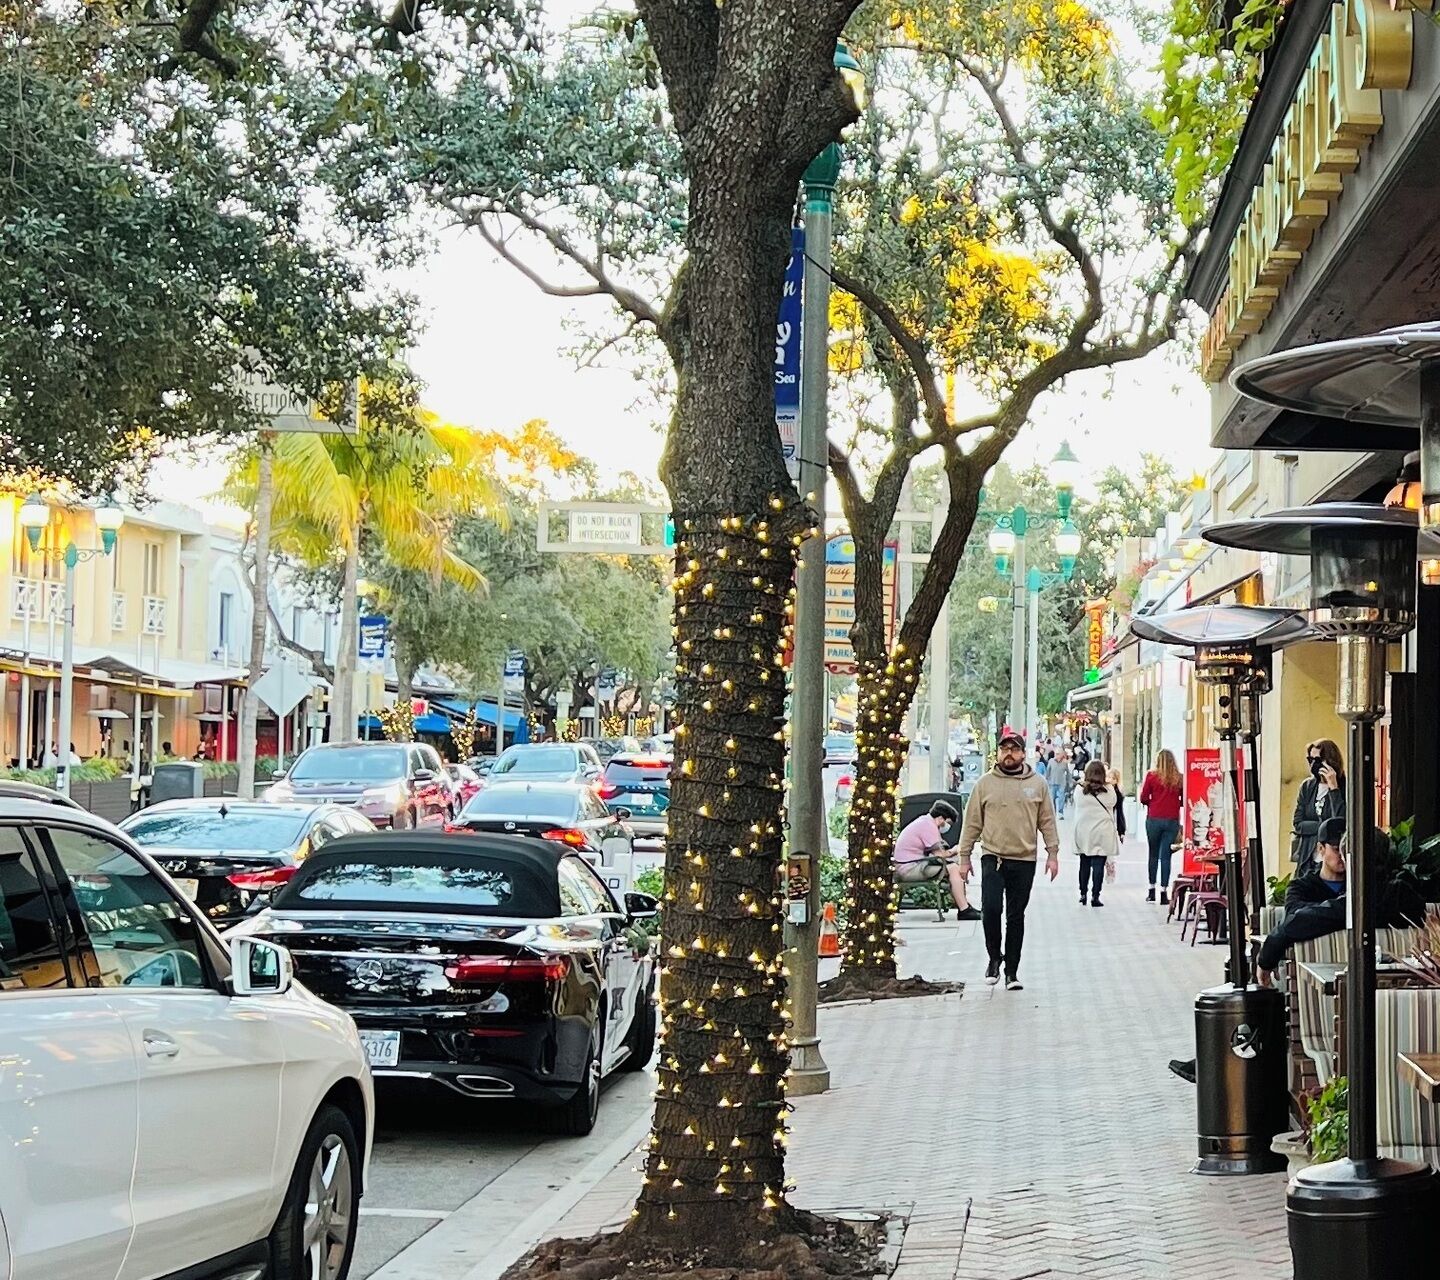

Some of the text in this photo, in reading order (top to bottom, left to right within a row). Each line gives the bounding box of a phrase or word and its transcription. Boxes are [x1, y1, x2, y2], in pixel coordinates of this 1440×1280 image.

[775, 371, 796, 385] Sea
[577, 515, 633, 526] DO NOT BLOCK
[578, 529, 631, 540] INTERSECTION
